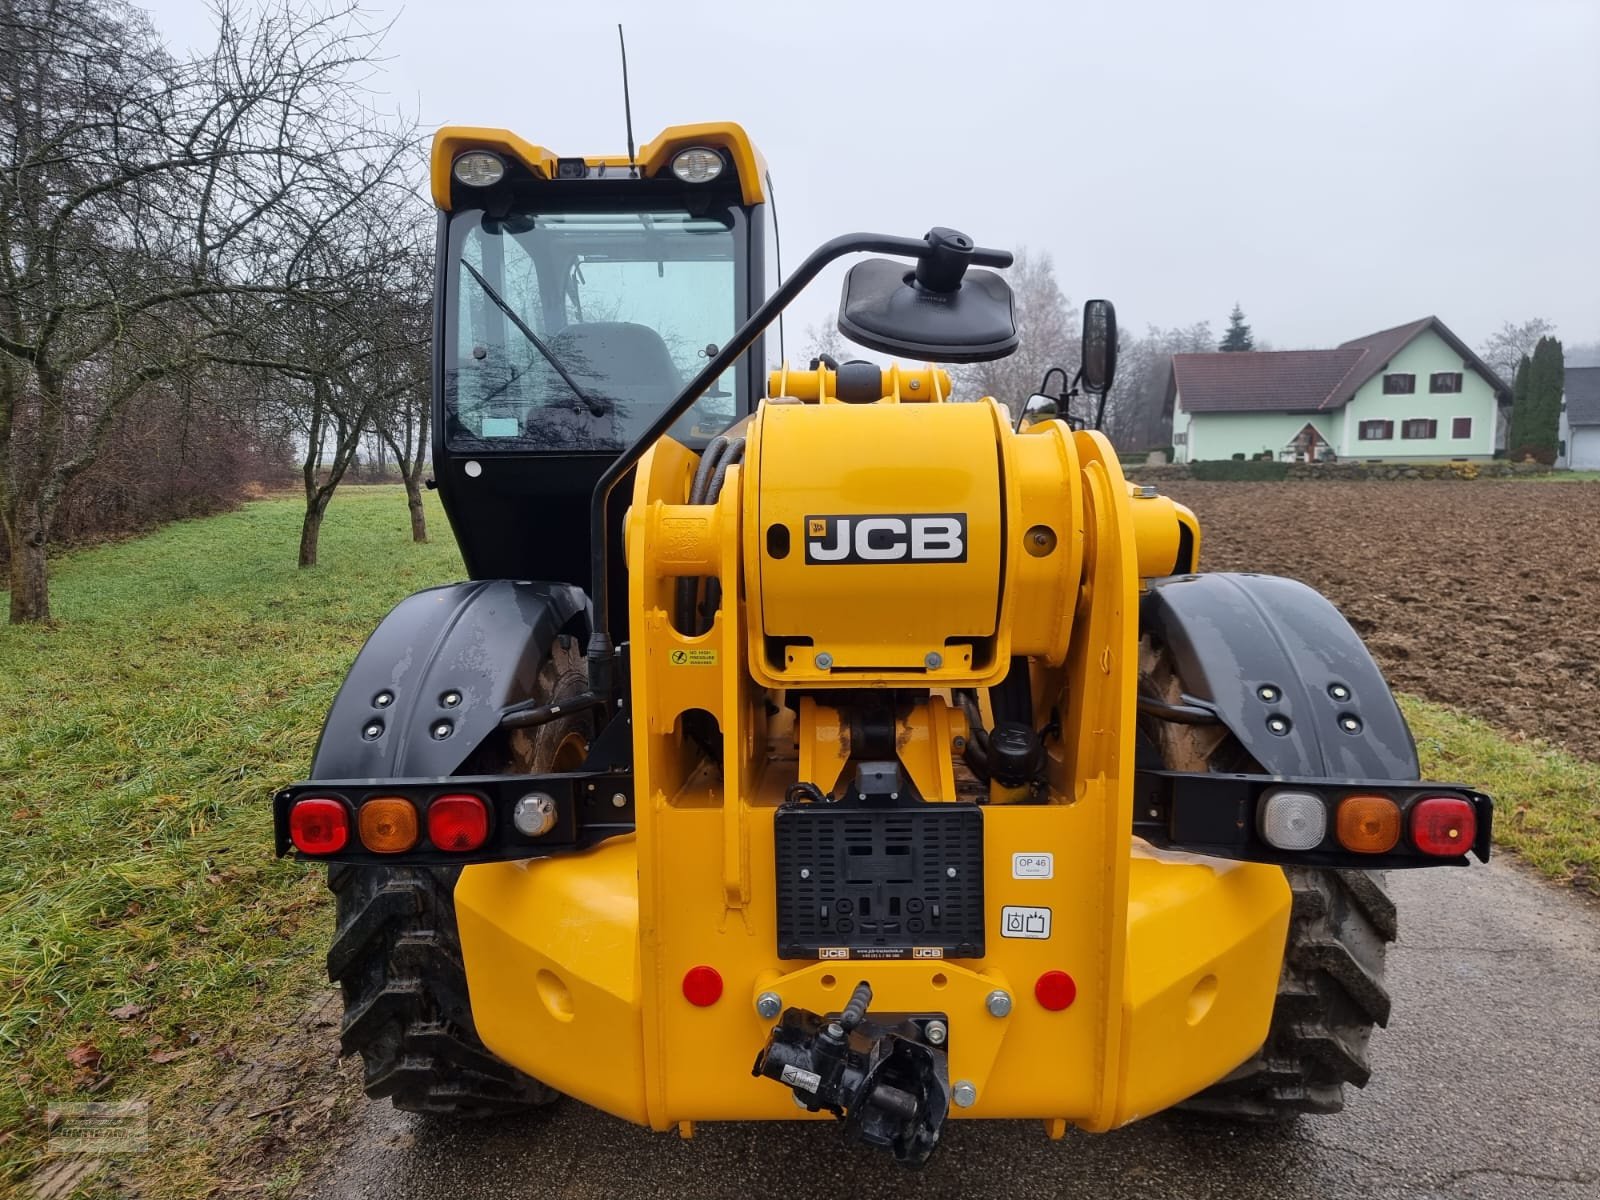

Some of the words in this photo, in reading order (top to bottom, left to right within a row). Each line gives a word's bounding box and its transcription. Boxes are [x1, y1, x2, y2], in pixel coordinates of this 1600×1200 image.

[809, 518, 963, 560] JCB
[1019, 858, 1032, 866] OP
[821, 949, 847, 958] JCB
[915, 949, 941, 958] JCB
